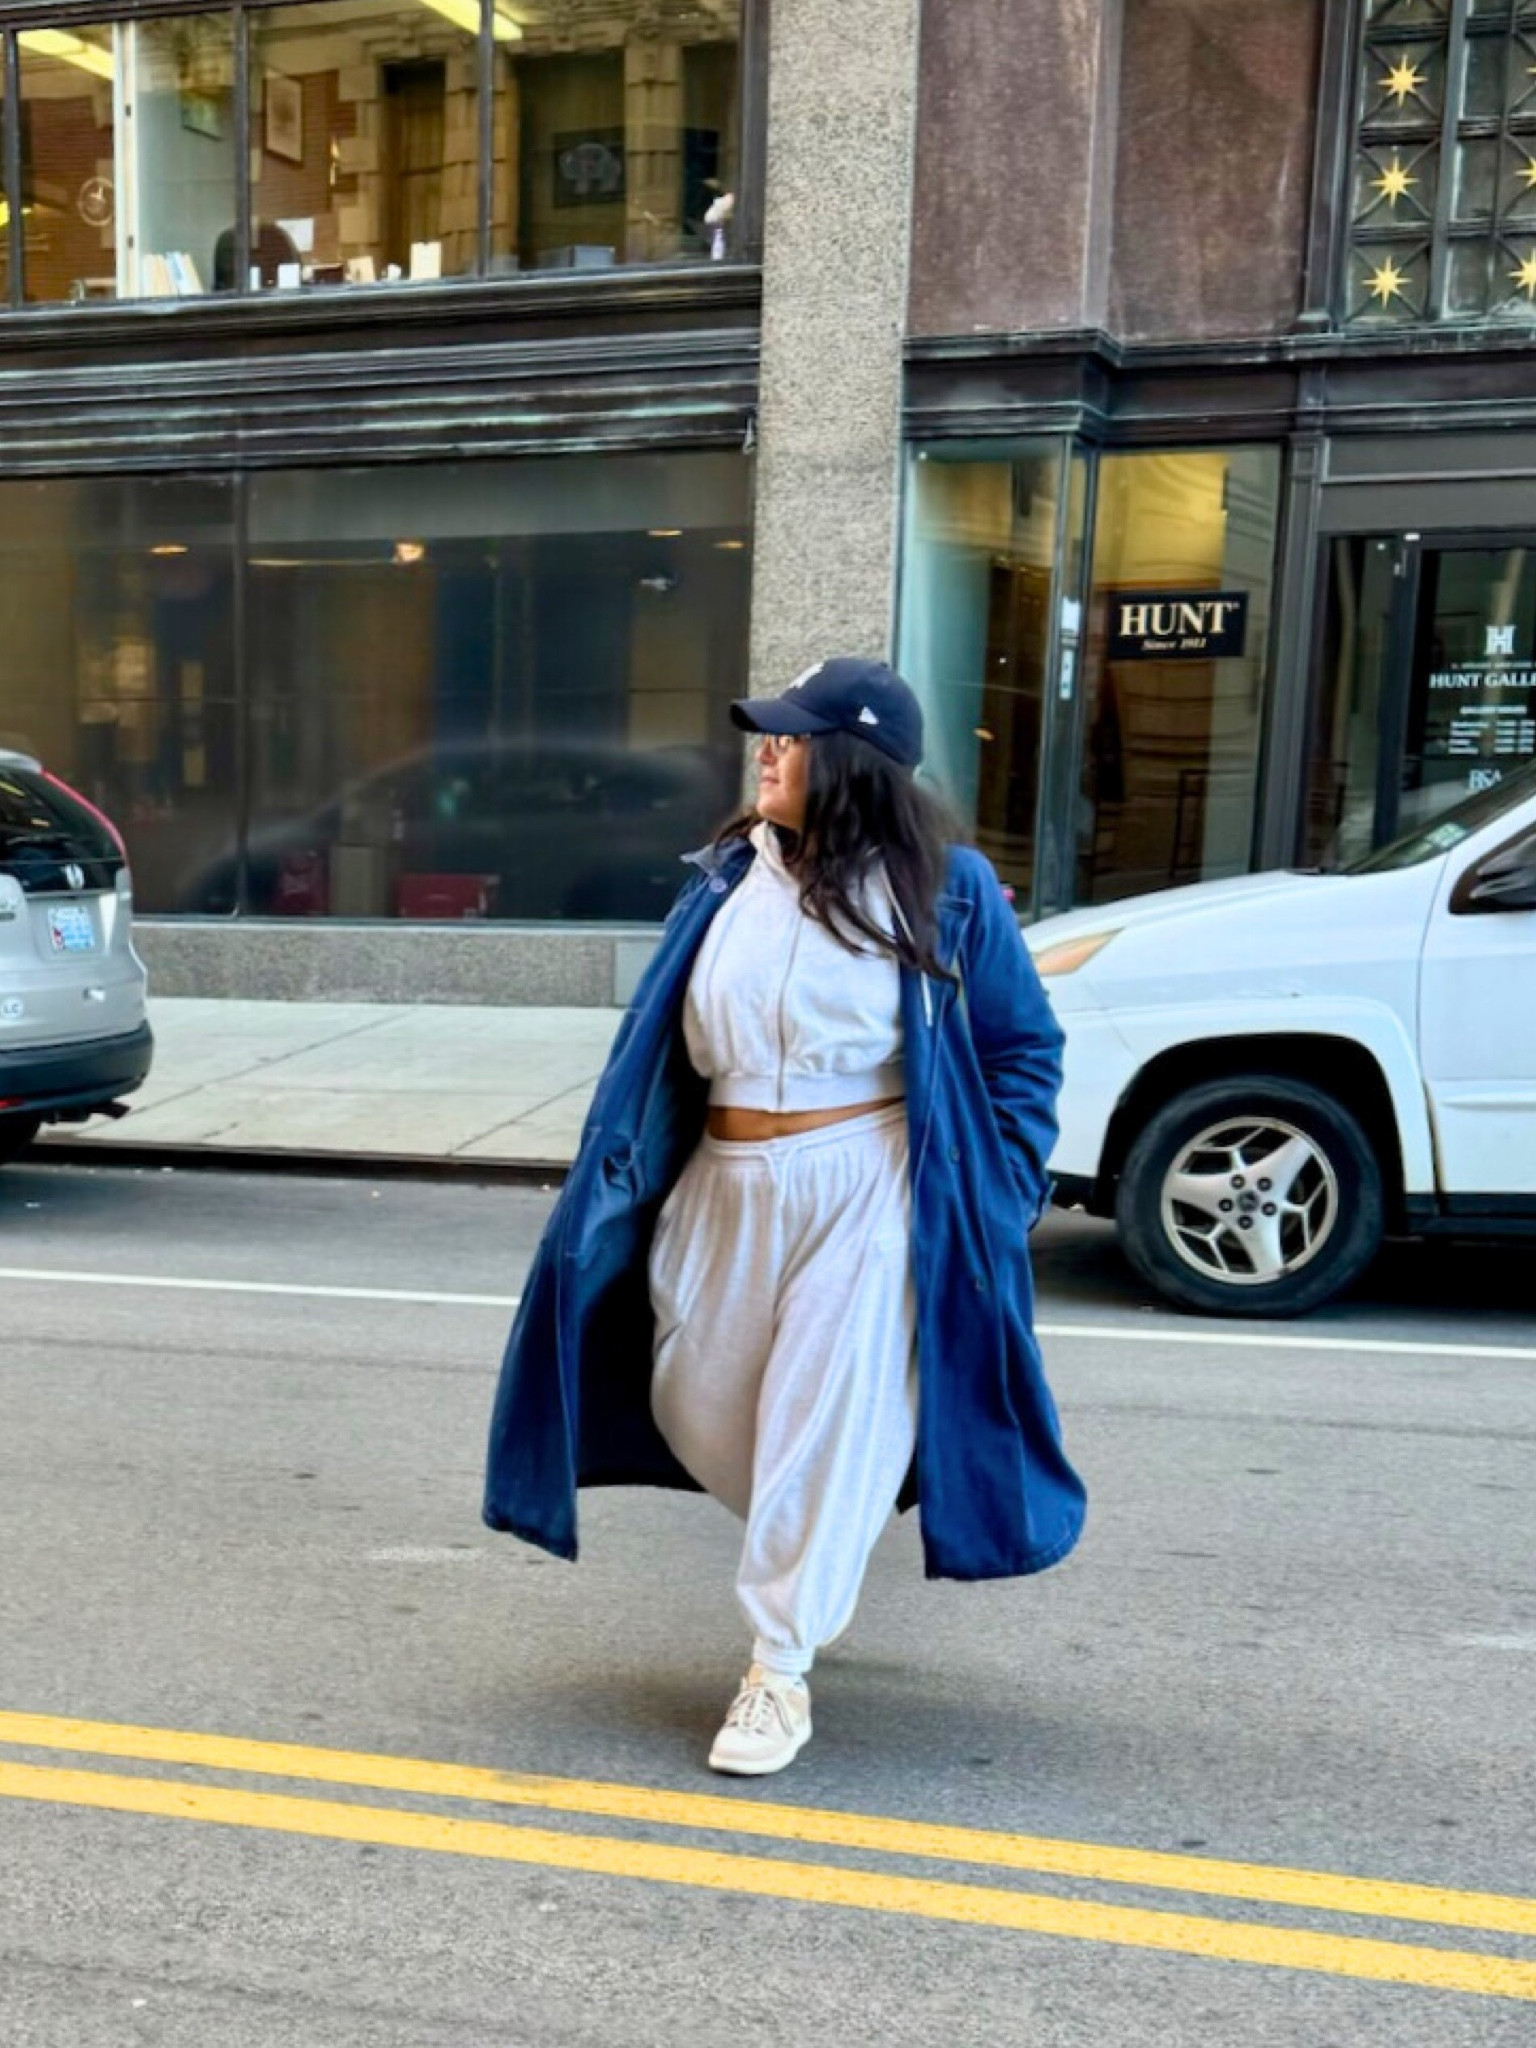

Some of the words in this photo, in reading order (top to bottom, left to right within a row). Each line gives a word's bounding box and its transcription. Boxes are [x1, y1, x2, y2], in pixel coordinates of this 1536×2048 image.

[1120, 602, 1230, 636] HUNT
[1485, 625, 1516, 655] H
[1429, 673, 1482, 688] HUNT
